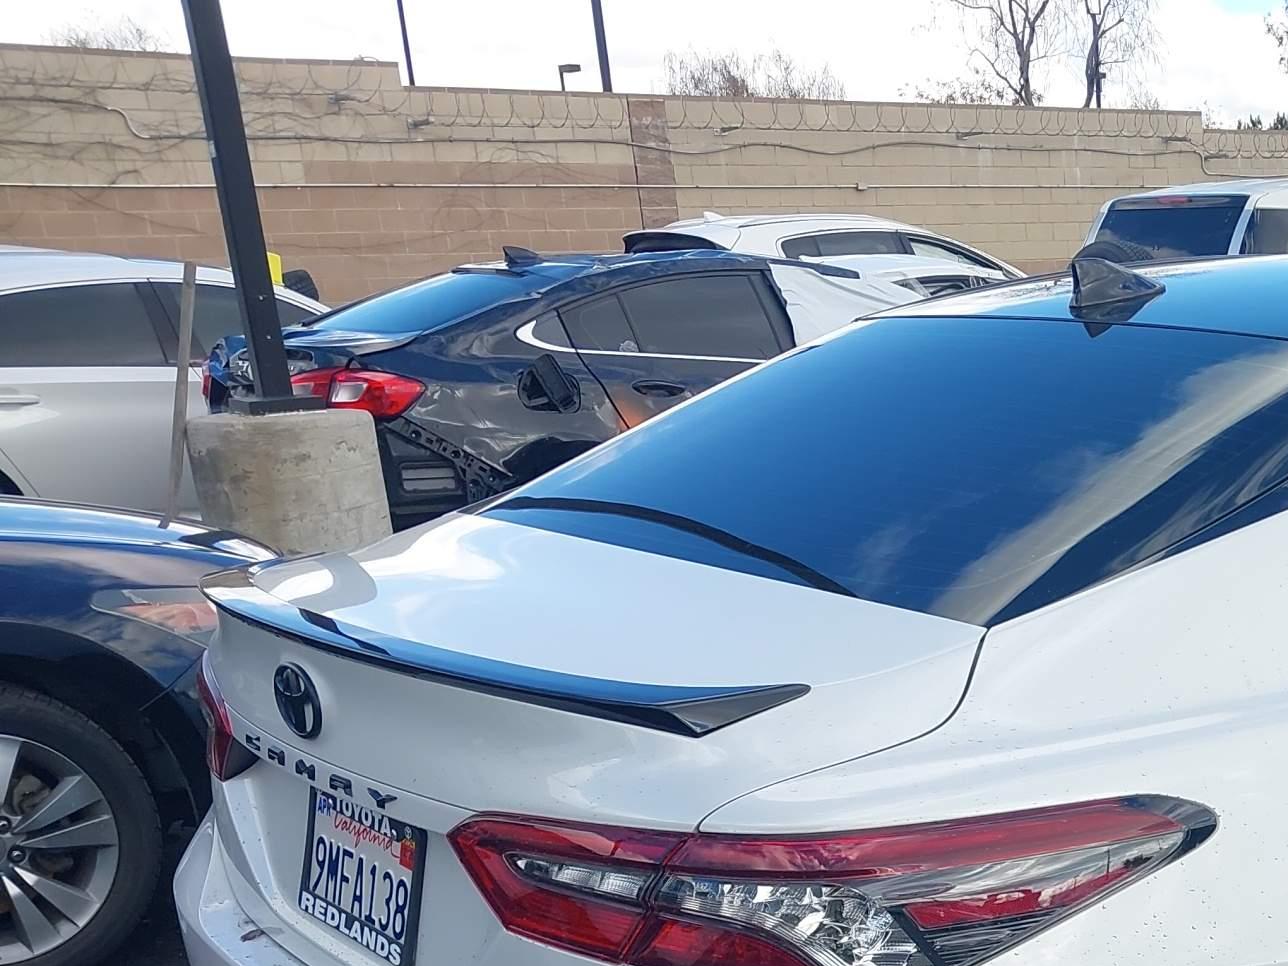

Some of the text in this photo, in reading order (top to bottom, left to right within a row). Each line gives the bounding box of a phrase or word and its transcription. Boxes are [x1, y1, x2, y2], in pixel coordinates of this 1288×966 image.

[246, 733, 397, 810] CAMRY
[335, 798, 392, 837] TOYOTA
[312, 836, 409, 941] 9MFA138
[300, 890, 402, 966] REDLANDS
